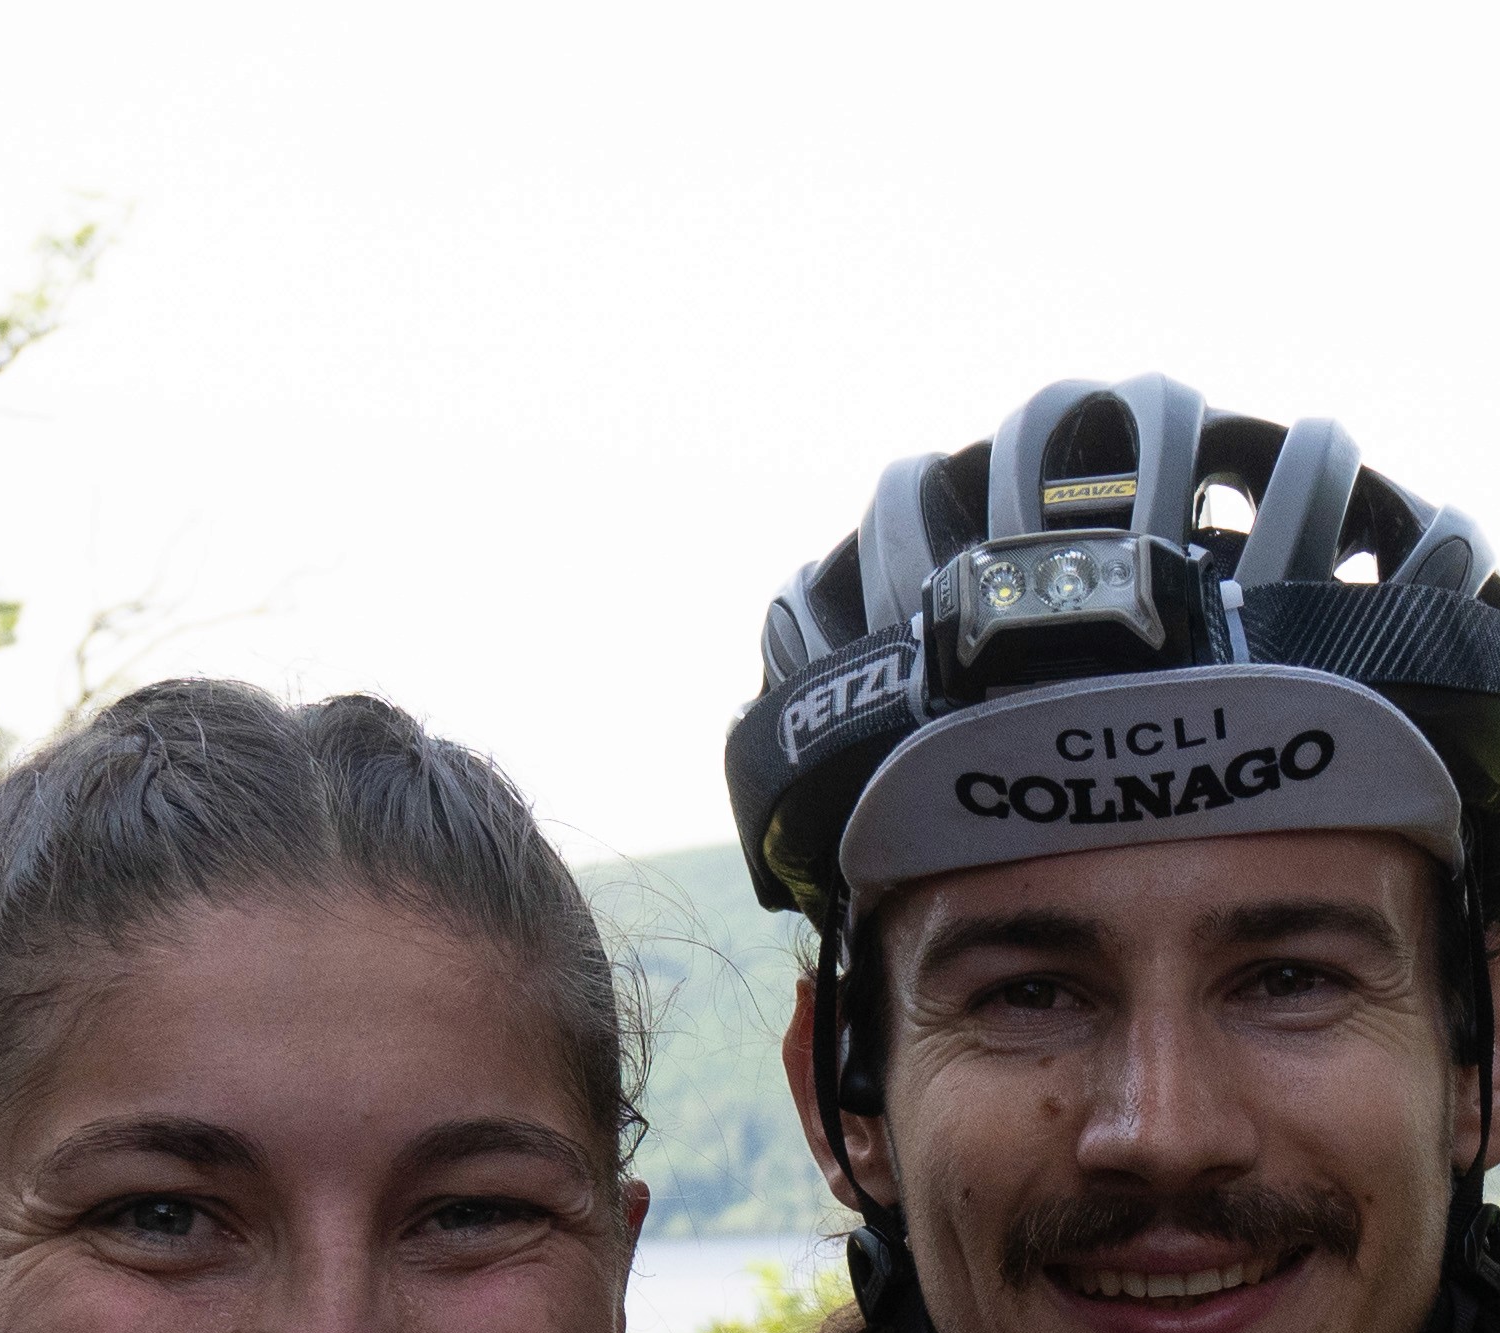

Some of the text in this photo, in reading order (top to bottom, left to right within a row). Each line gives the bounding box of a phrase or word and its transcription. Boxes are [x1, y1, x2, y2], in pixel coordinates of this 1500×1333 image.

[1049, 483, 1132, 501] MAVIC
[783, 652, 911, 765] PETZL
[1055, 707, 1227, 762] CICLI
[954, 729, 1336, 825] COLNAGO
